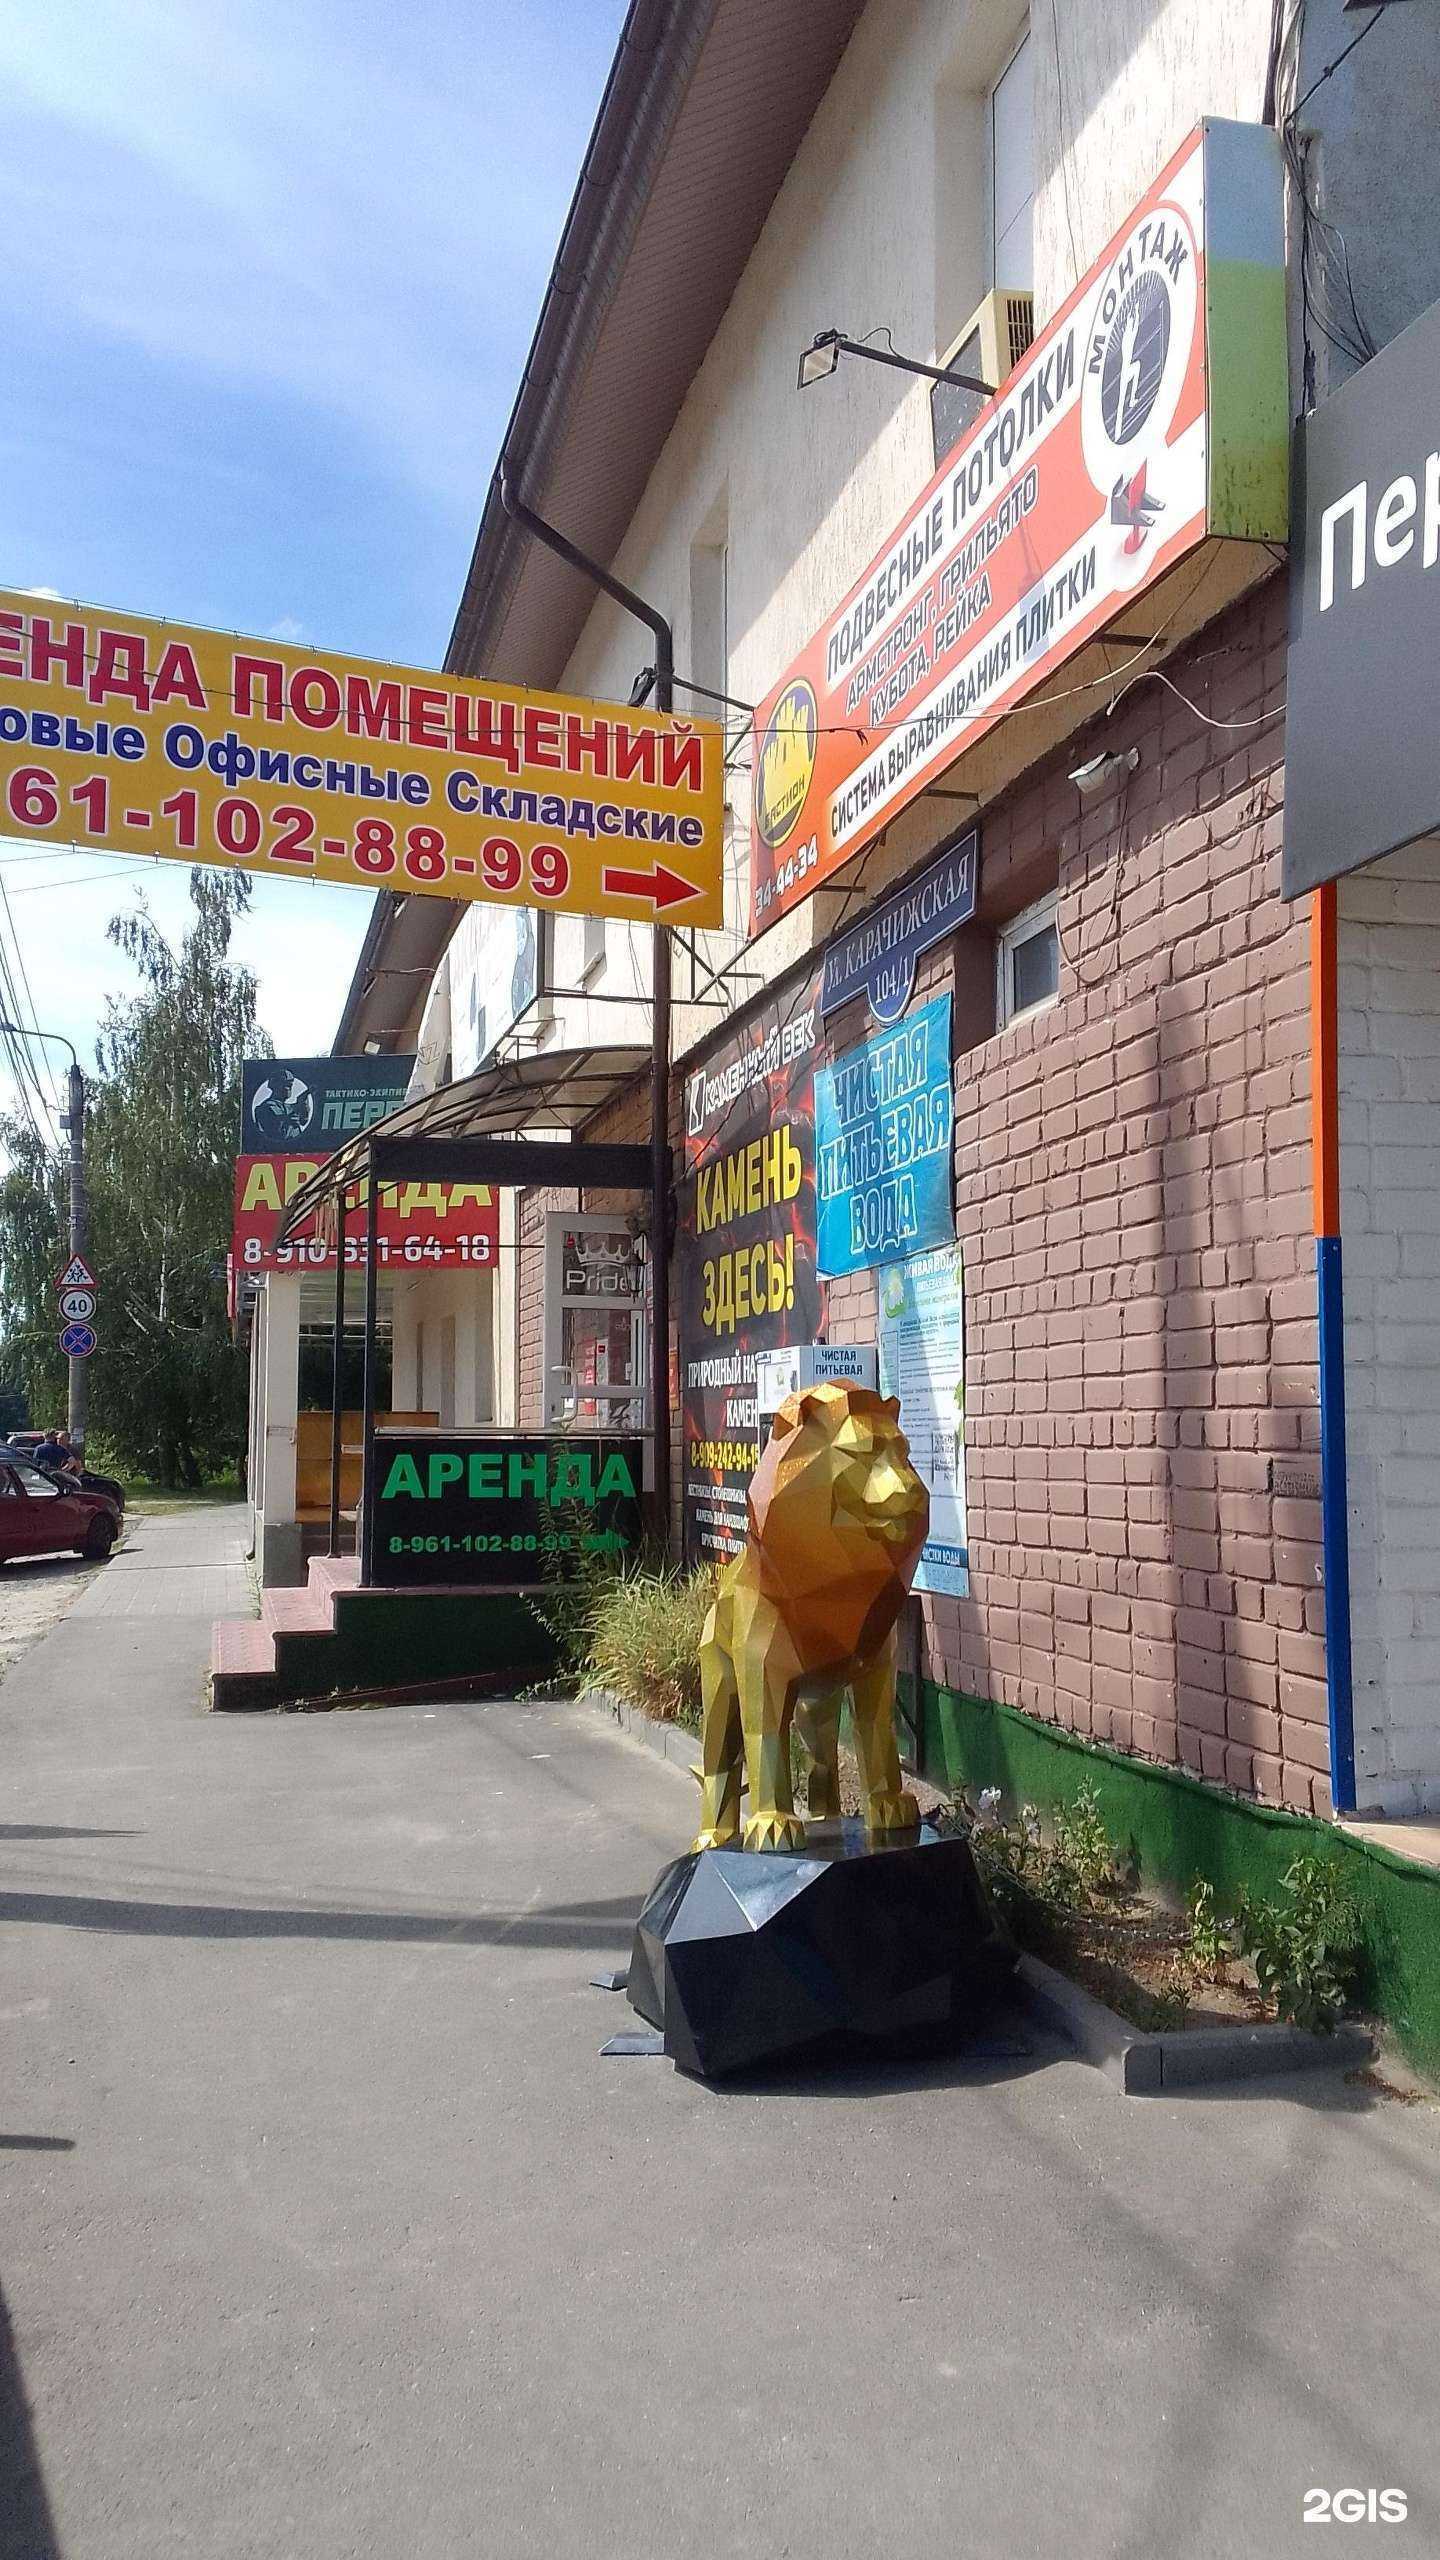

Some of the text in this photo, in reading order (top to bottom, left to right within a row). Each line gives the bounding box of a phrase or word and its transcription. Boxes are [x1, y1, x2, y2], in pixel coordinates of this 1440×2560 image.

[1088, 220, 1189, 374] МОНТАЖ
[827, 327, 1075, 683] ПОДВЕСНЫЕ ПОТОЛКИ
[846, 466, 1038, 714] АРМСТРОНГ, ГРИЛЬЯТО
[831, 545, 1096, 838] СИСТЕМА ВЫРАВНИВАНИЯ ПЛИТКИ
[871, 573, 991, 727] КУБОТА, РЕЙКА
[234, 655, 702, 792] ПОМЕЩЕНИЙ
[9, 767, 569, 897] 61-102-88-99
[165, 723, 431, 805] Офисные
[448, 771, 703, 846] Складские
[756, 833, 818, 917] 34-44-34
[844, 853, 970, 978] КАРАЧИЖСКАЯ
[875, 956, 910, 1005] 104/1
[705, 1024, 781, 1116] КАМЕННЫЙ
[782, 1008, 816, 1066] ВЕК
[833, 1020, 929, 1127] ЧИСТАЯ
[696, 1124, 802, 1235] КАМЕНЬ
[820, 1081, 953, 1200] ПИТЬЕВАЯ
[851, 1174, 917, 1252] ВОДА
[67, 1299, 88, 1313] 40
[702, 1232, 795, 1337] ЗДЕСЬ!
[688, 1349, 742, 1389] ПРИРОДНЫЙ
[815, 1364, 863, 1376] ПИТЬЕВАЯ
[821, 1350, 857, 1361] ЧИСТАЯ
[381, 1453, 636, 1507] АРЕНДА
